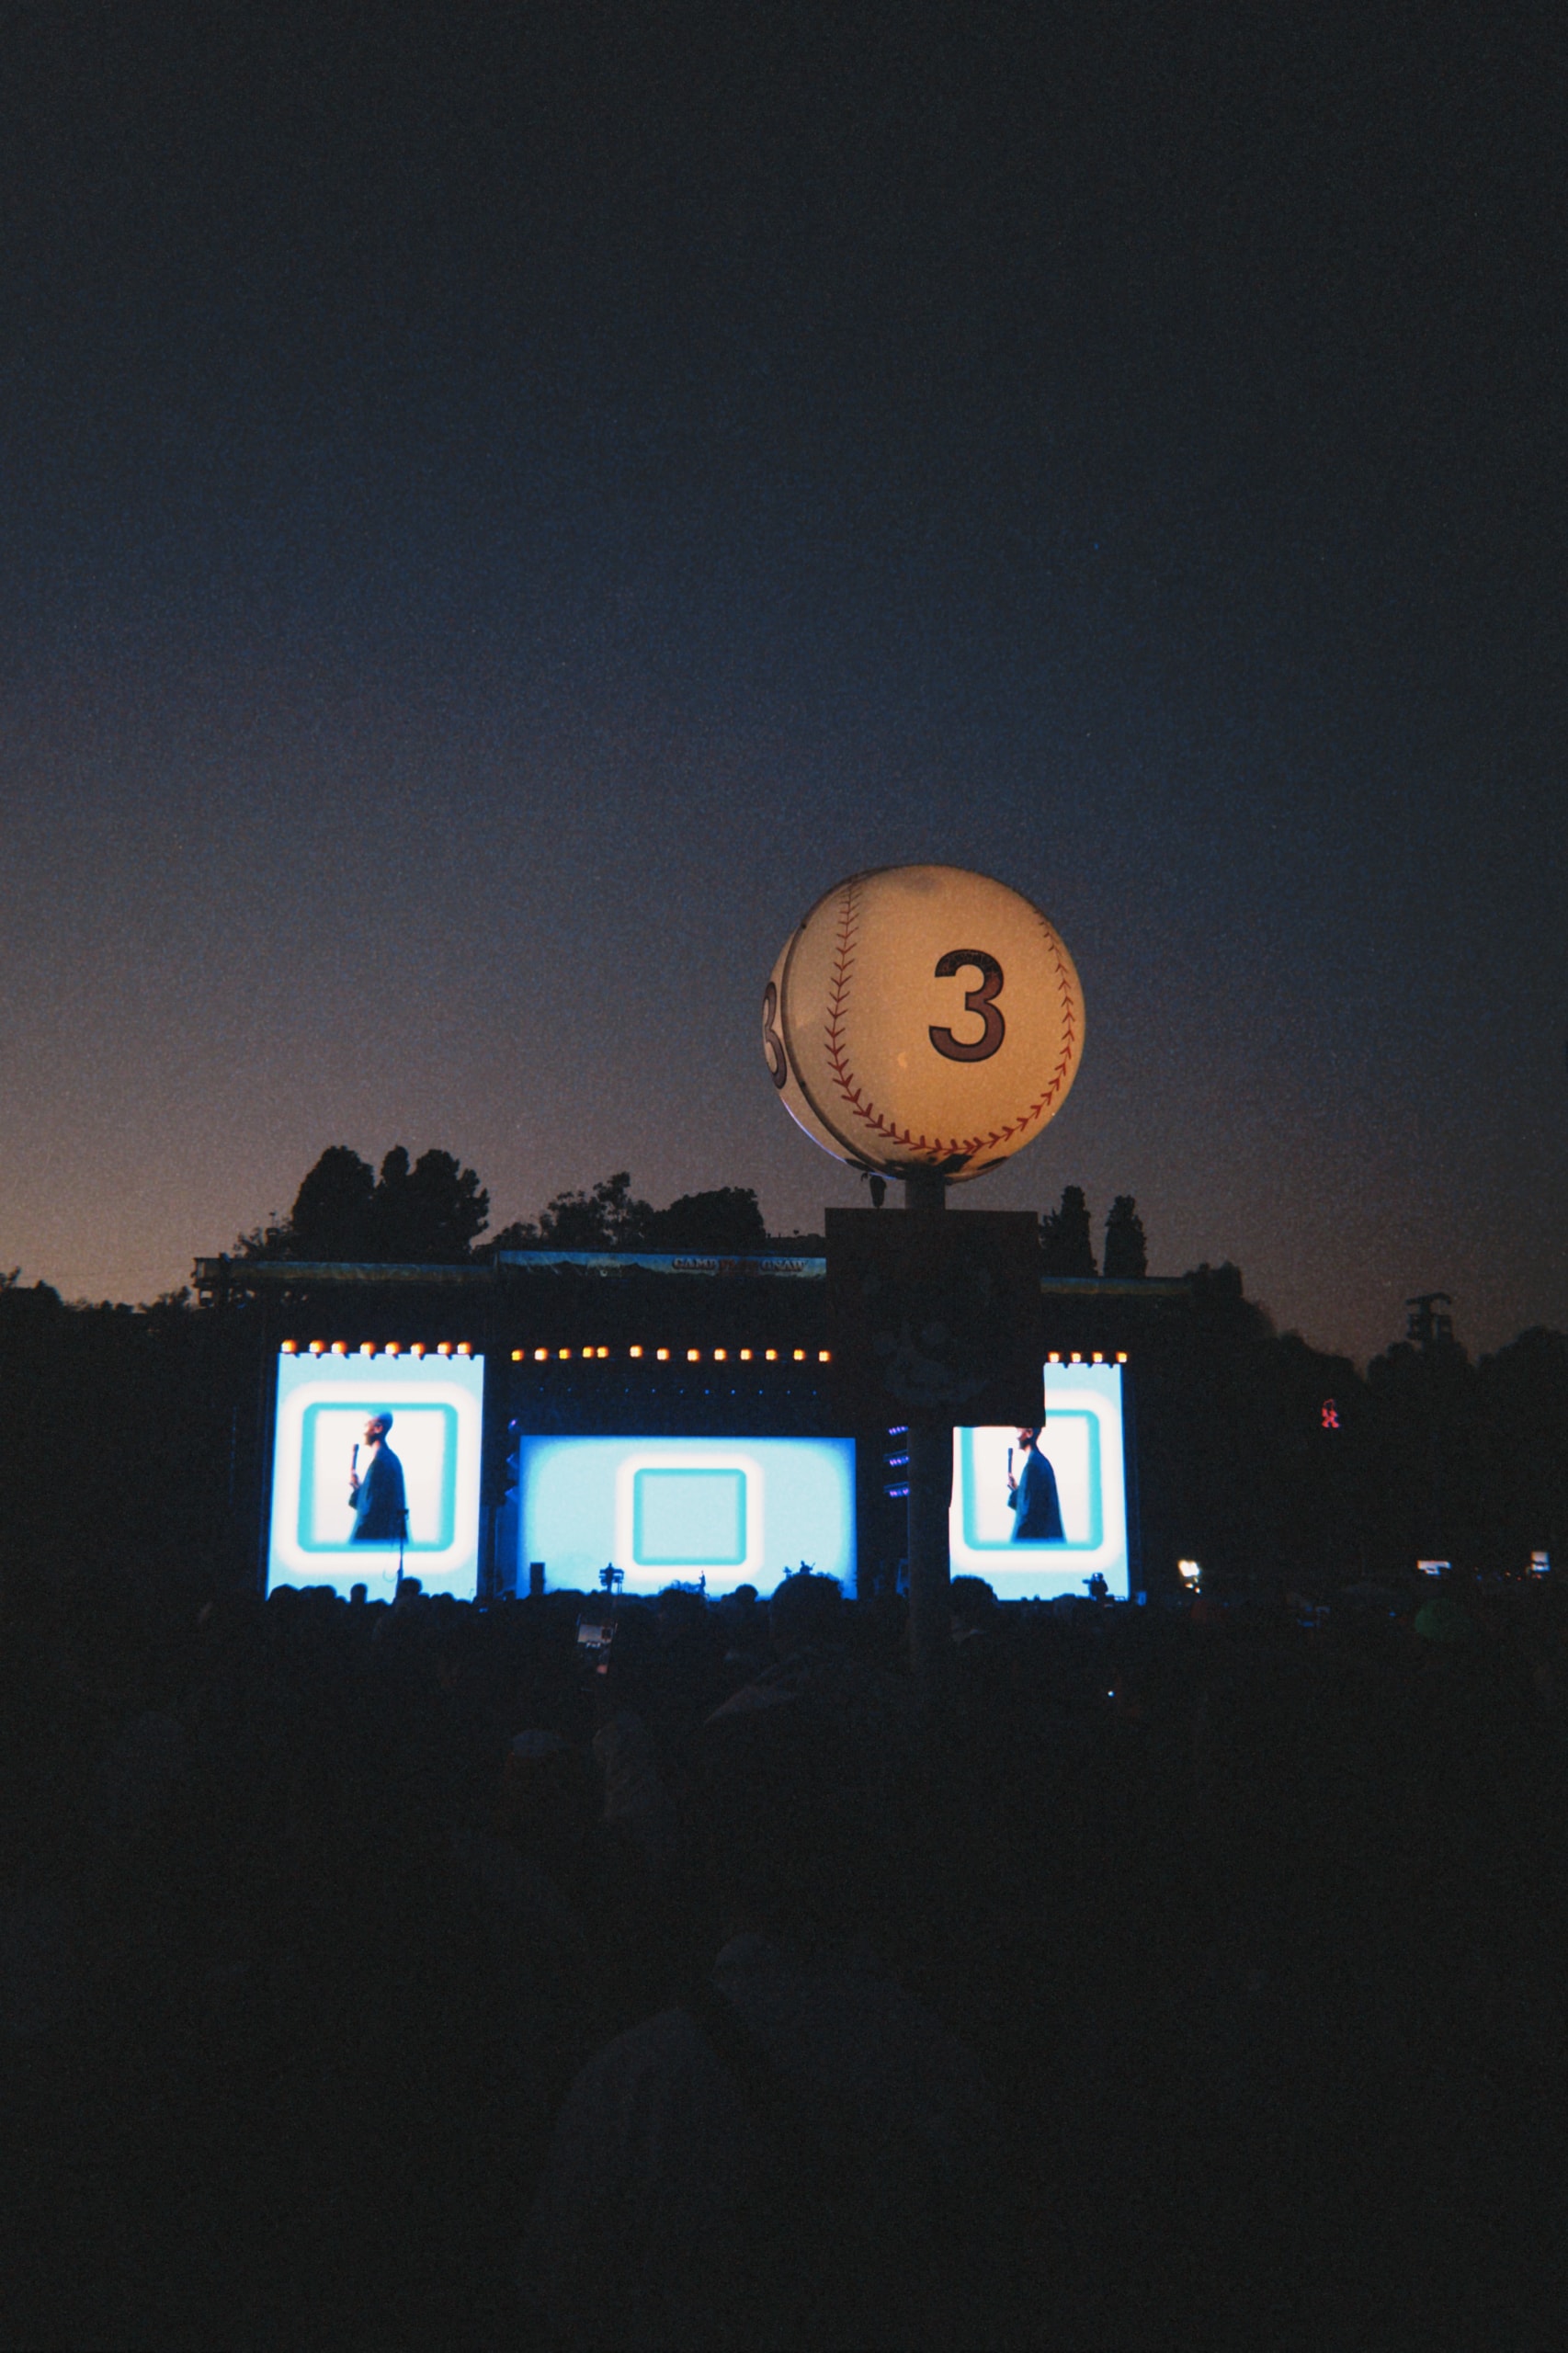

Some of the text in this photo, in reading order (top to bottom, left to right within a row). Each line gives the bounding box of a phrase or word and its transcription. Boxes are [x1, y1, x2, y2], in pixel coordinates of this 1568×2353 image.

[762, 982, 787, 1089] 3
[928, 949, 1006, 1063] 3
[673, 1257, 717, 1270] CAMP
